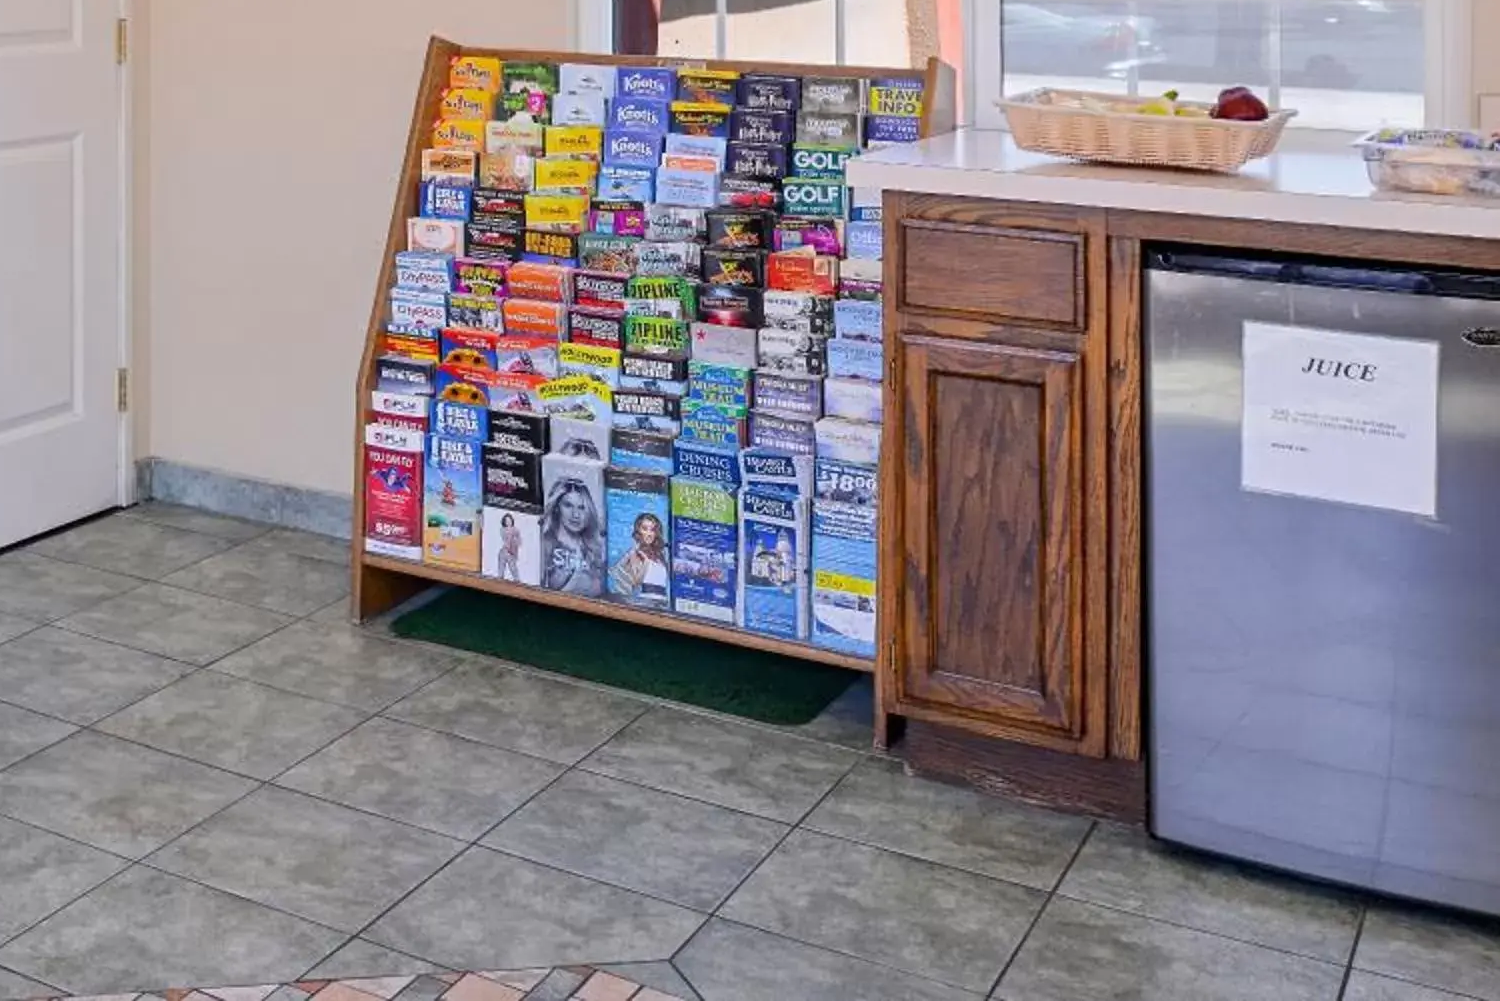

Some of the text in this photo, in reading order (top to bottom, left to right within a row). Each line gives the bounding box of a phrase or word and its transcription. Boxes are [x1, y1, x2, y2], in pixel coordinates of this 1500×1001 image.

[878, 88, 922, 102] TRAVE
[878, 102, 917, 114] INFO
[794, 150, 849, 171] GOLF
[783, 185, 839, 203] GOLF
[1300, 357, 1378, 383] JUICE
